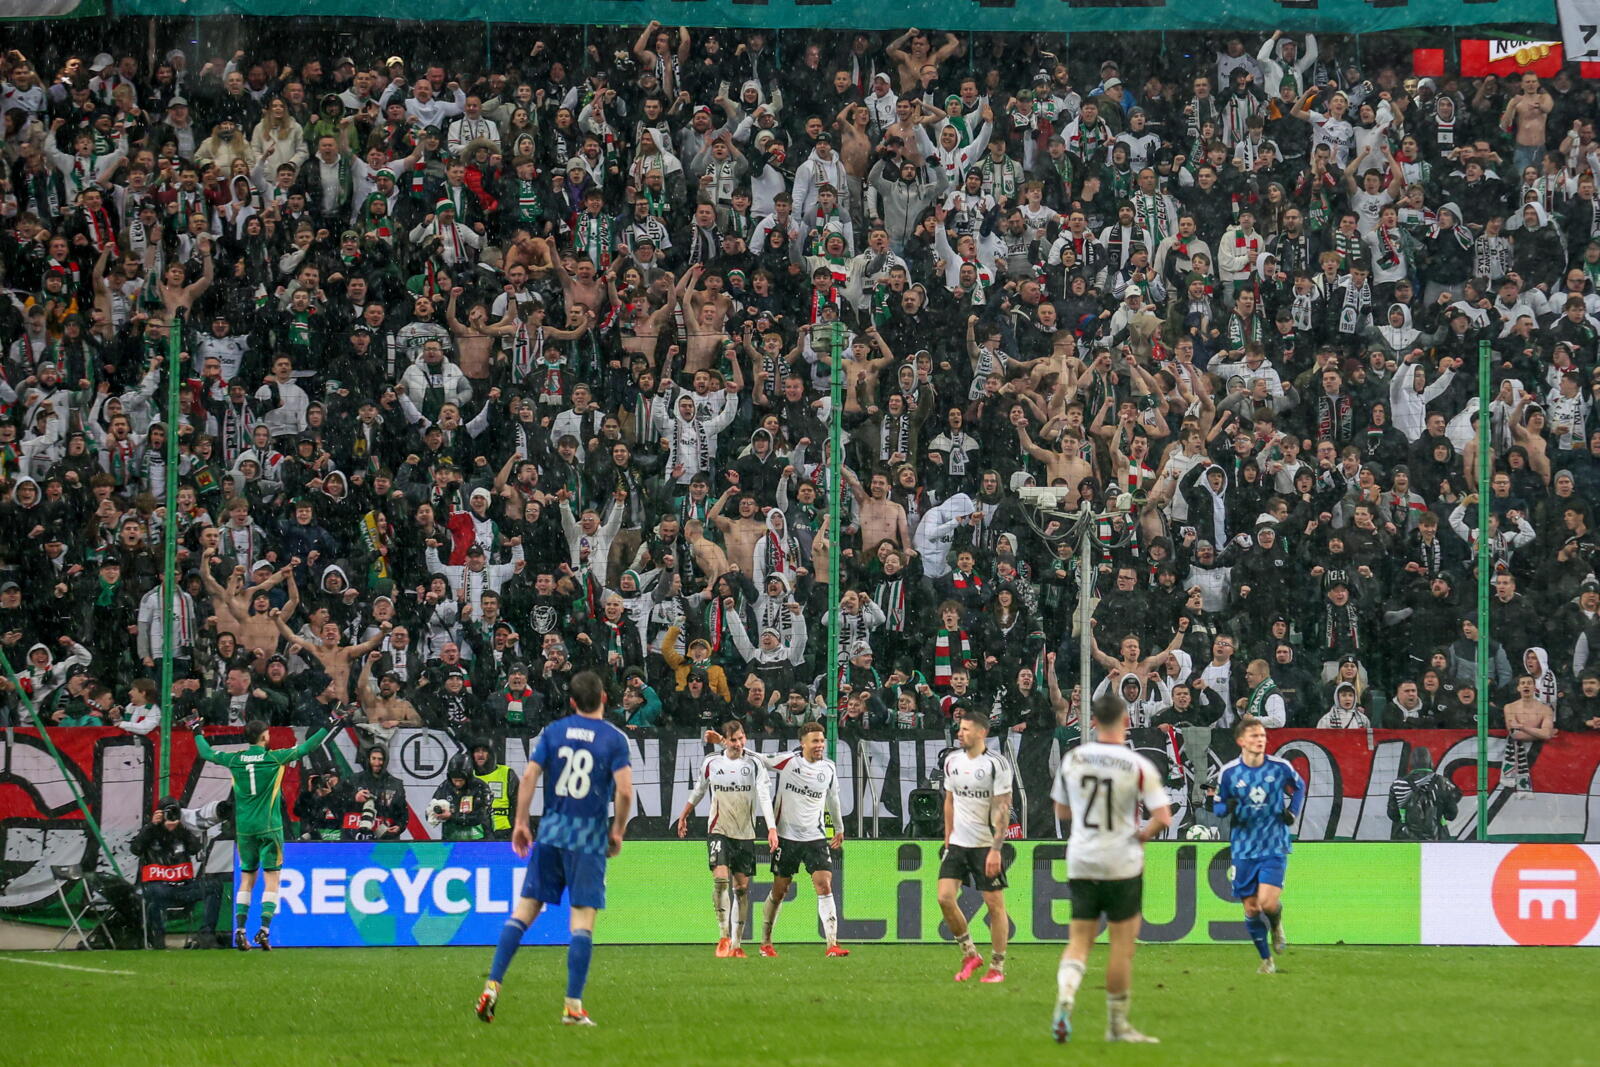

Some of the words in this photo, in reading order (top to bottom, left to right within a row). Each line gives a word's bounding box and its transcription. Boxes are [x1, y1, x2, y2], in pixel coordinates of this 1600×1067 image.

[245, 763, 257, 796] 1
[554, 745, 594, 800] 28
[713, 783, 751, 793] Plus500
[785, 783, 823, 800] Plus500
[1080, 775, 1113, 833] 21
[709, 841, 722, 854] 24
